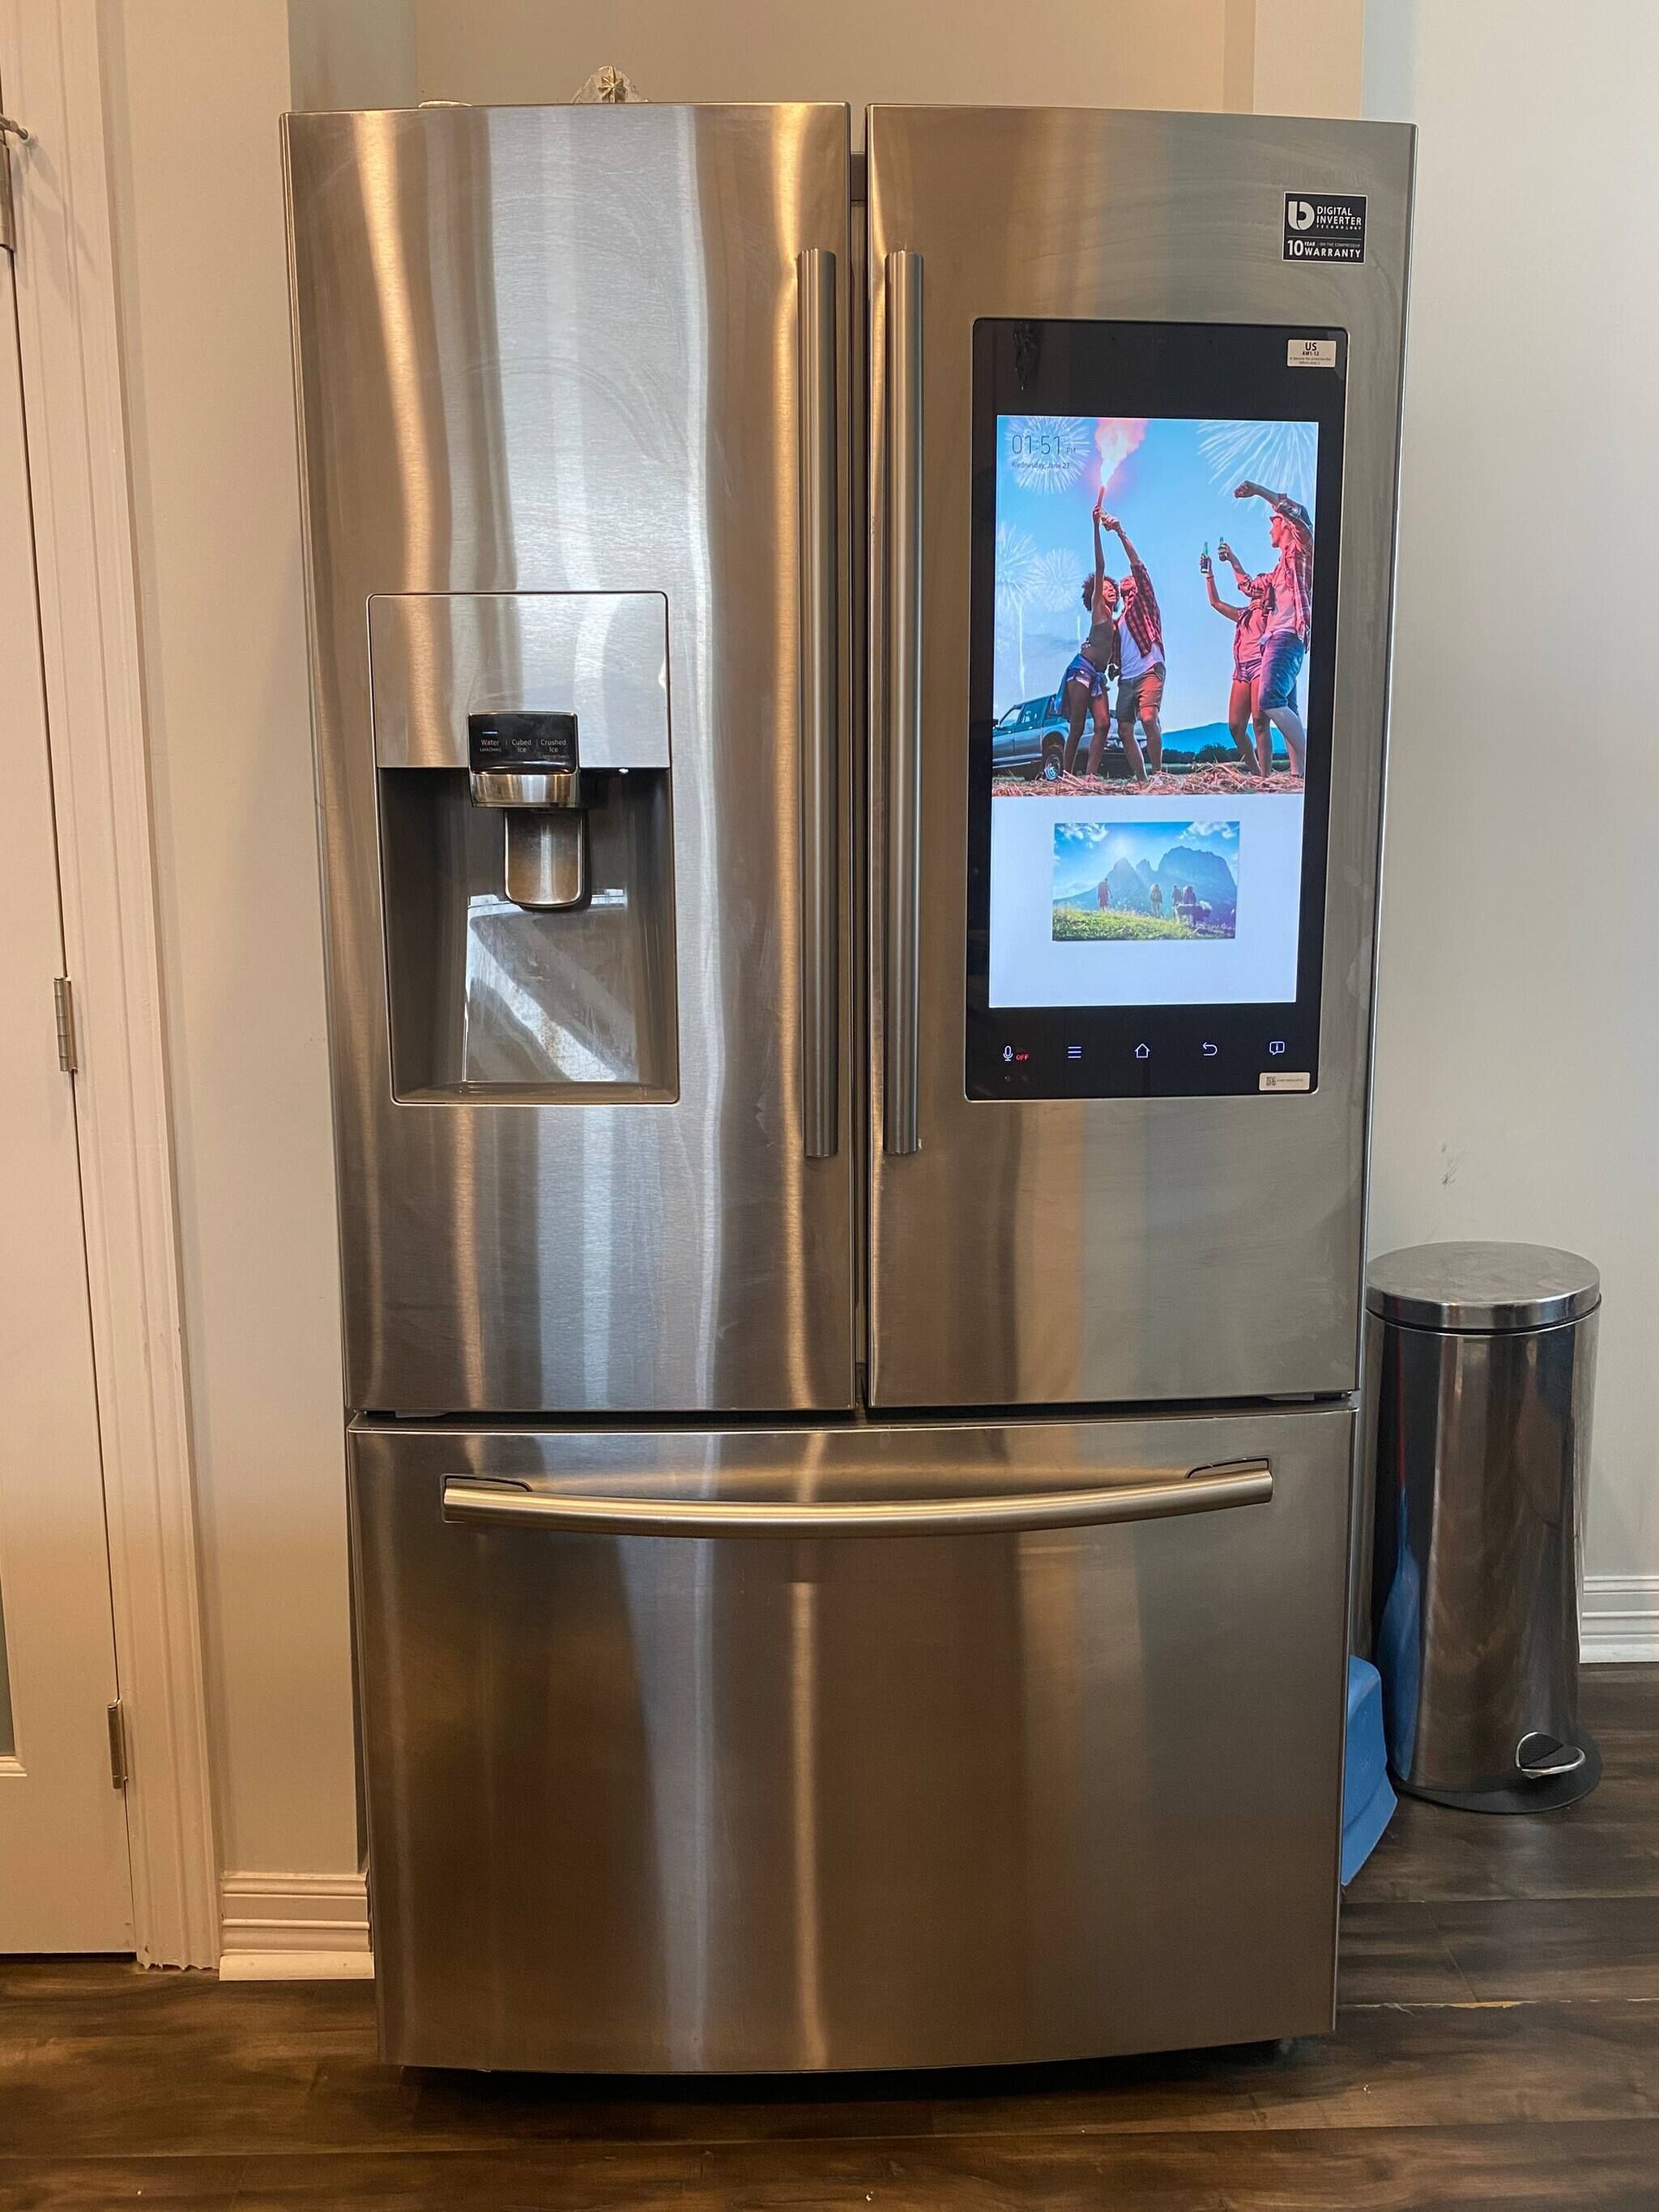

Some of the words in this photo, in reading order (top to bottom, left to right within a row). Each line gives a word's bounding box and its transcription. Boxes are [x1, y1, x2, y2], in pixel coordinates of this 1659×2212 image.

[1316, 206, 1352, 215] DIGITAL
[1316, 215, 1362, 225] INVERTER
[1286, 240, 1303, 256] 10
[1304, 247, 1361, 258] WARRANTY
[1305, 342, 1317, 351] US
[1012, 434, 1060, 455] 01:51
